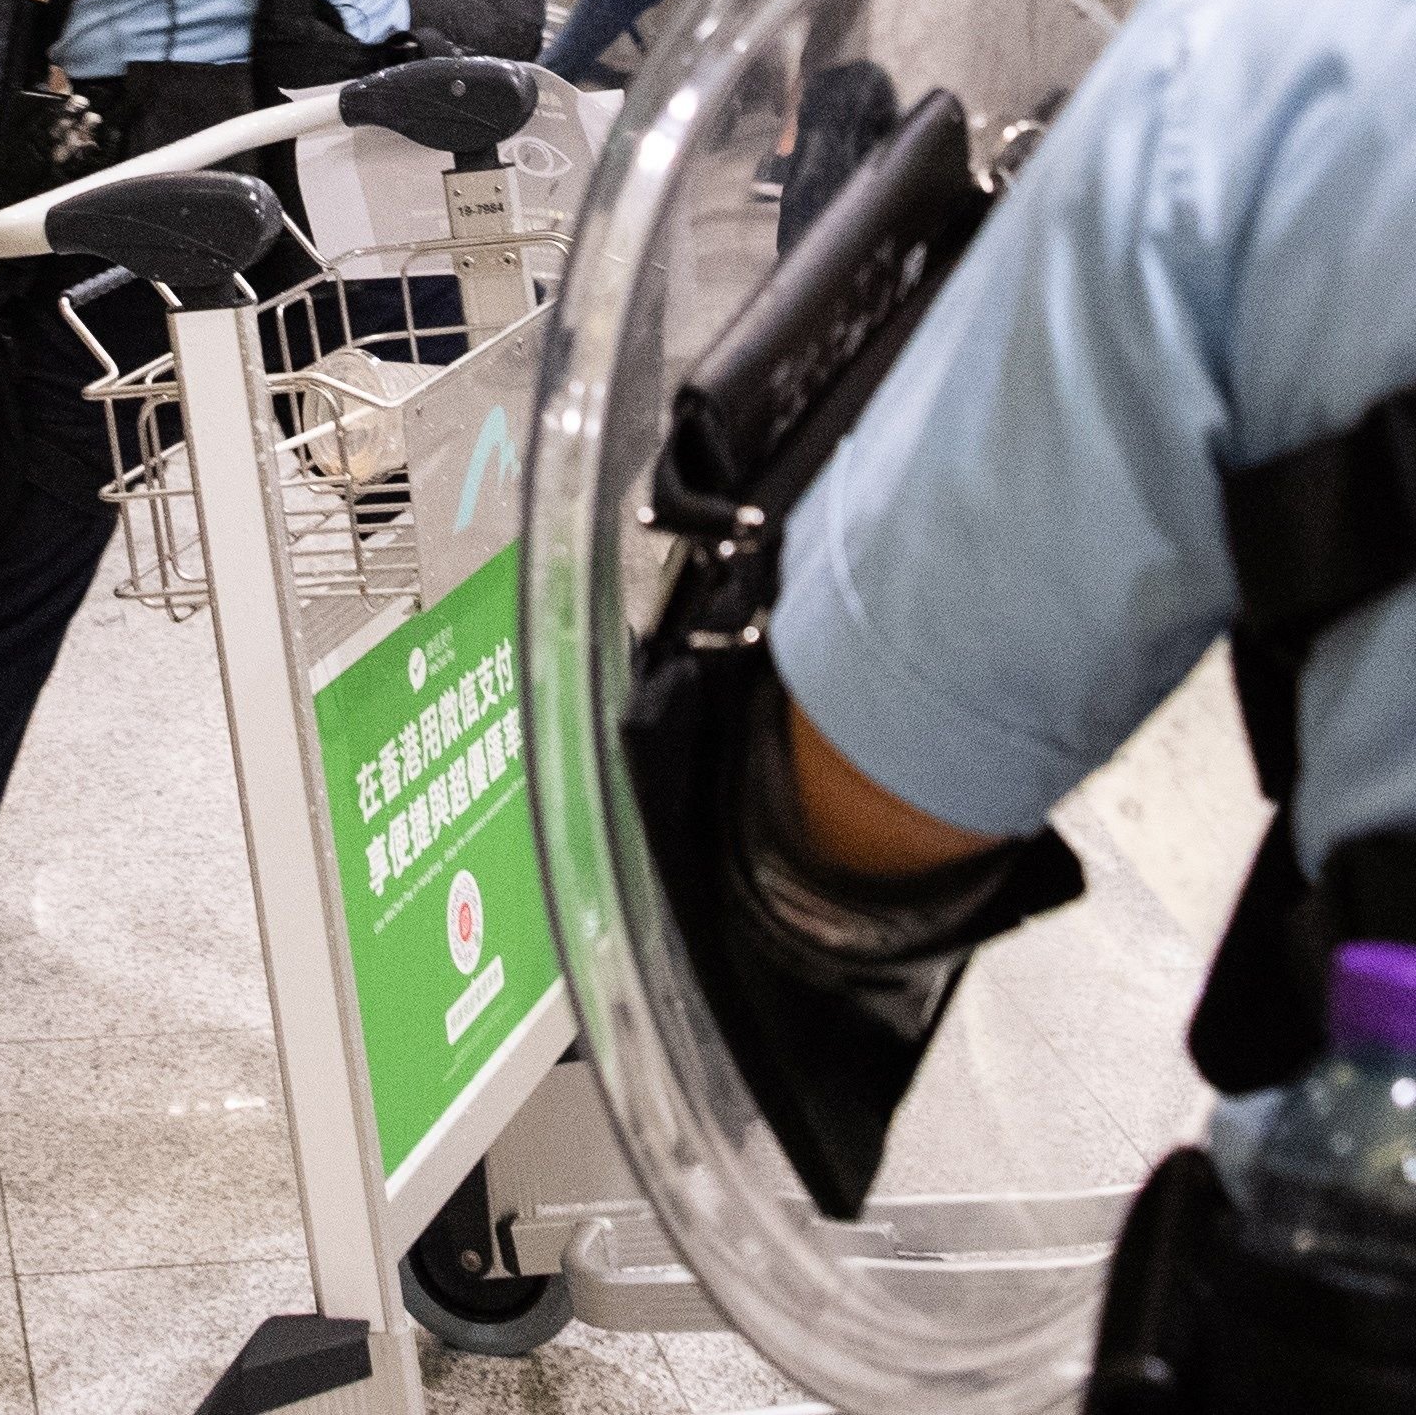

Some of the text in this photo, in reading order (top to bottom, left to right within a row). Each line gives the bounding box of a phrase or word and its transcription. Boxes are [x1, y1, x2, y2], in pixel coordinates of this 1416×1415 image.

[356, 637, 514, 824] 在香港用微信支付
